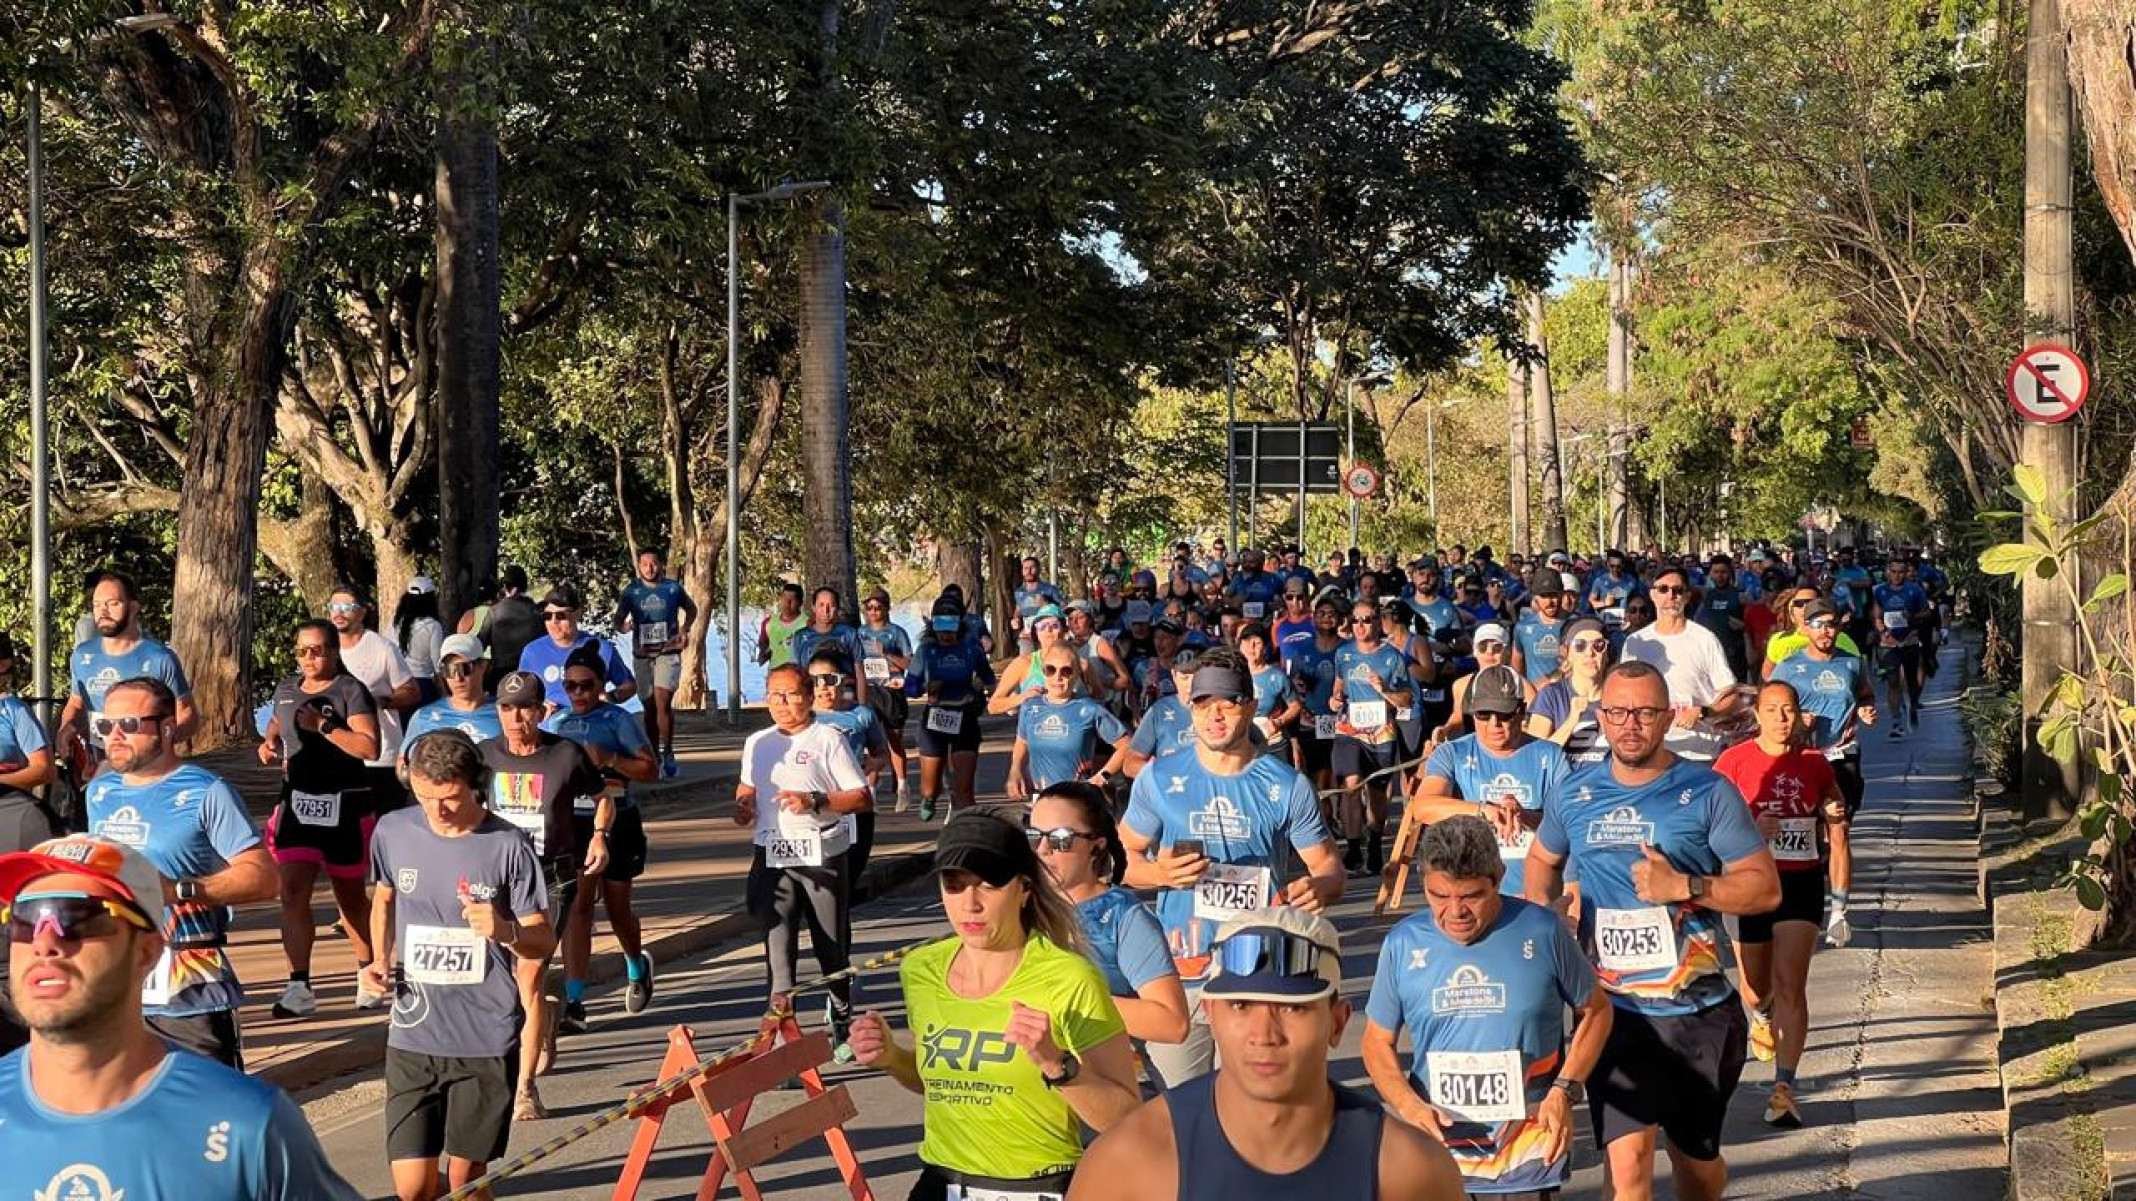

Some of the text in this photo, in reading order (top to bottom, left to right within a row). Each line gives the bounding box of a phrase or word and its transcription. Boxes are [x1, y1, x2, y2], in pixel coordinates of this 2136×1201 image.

[2036, 364, 2063, 403] E
[1202, 882, 1258, 911] 30256
[1602, 926, 1662, 956] 30253
[414, 943, 473, 972] 27257
[926, 1028, 1017, 1072] RP
[1440, 1073, 1509, 1104] 30148
